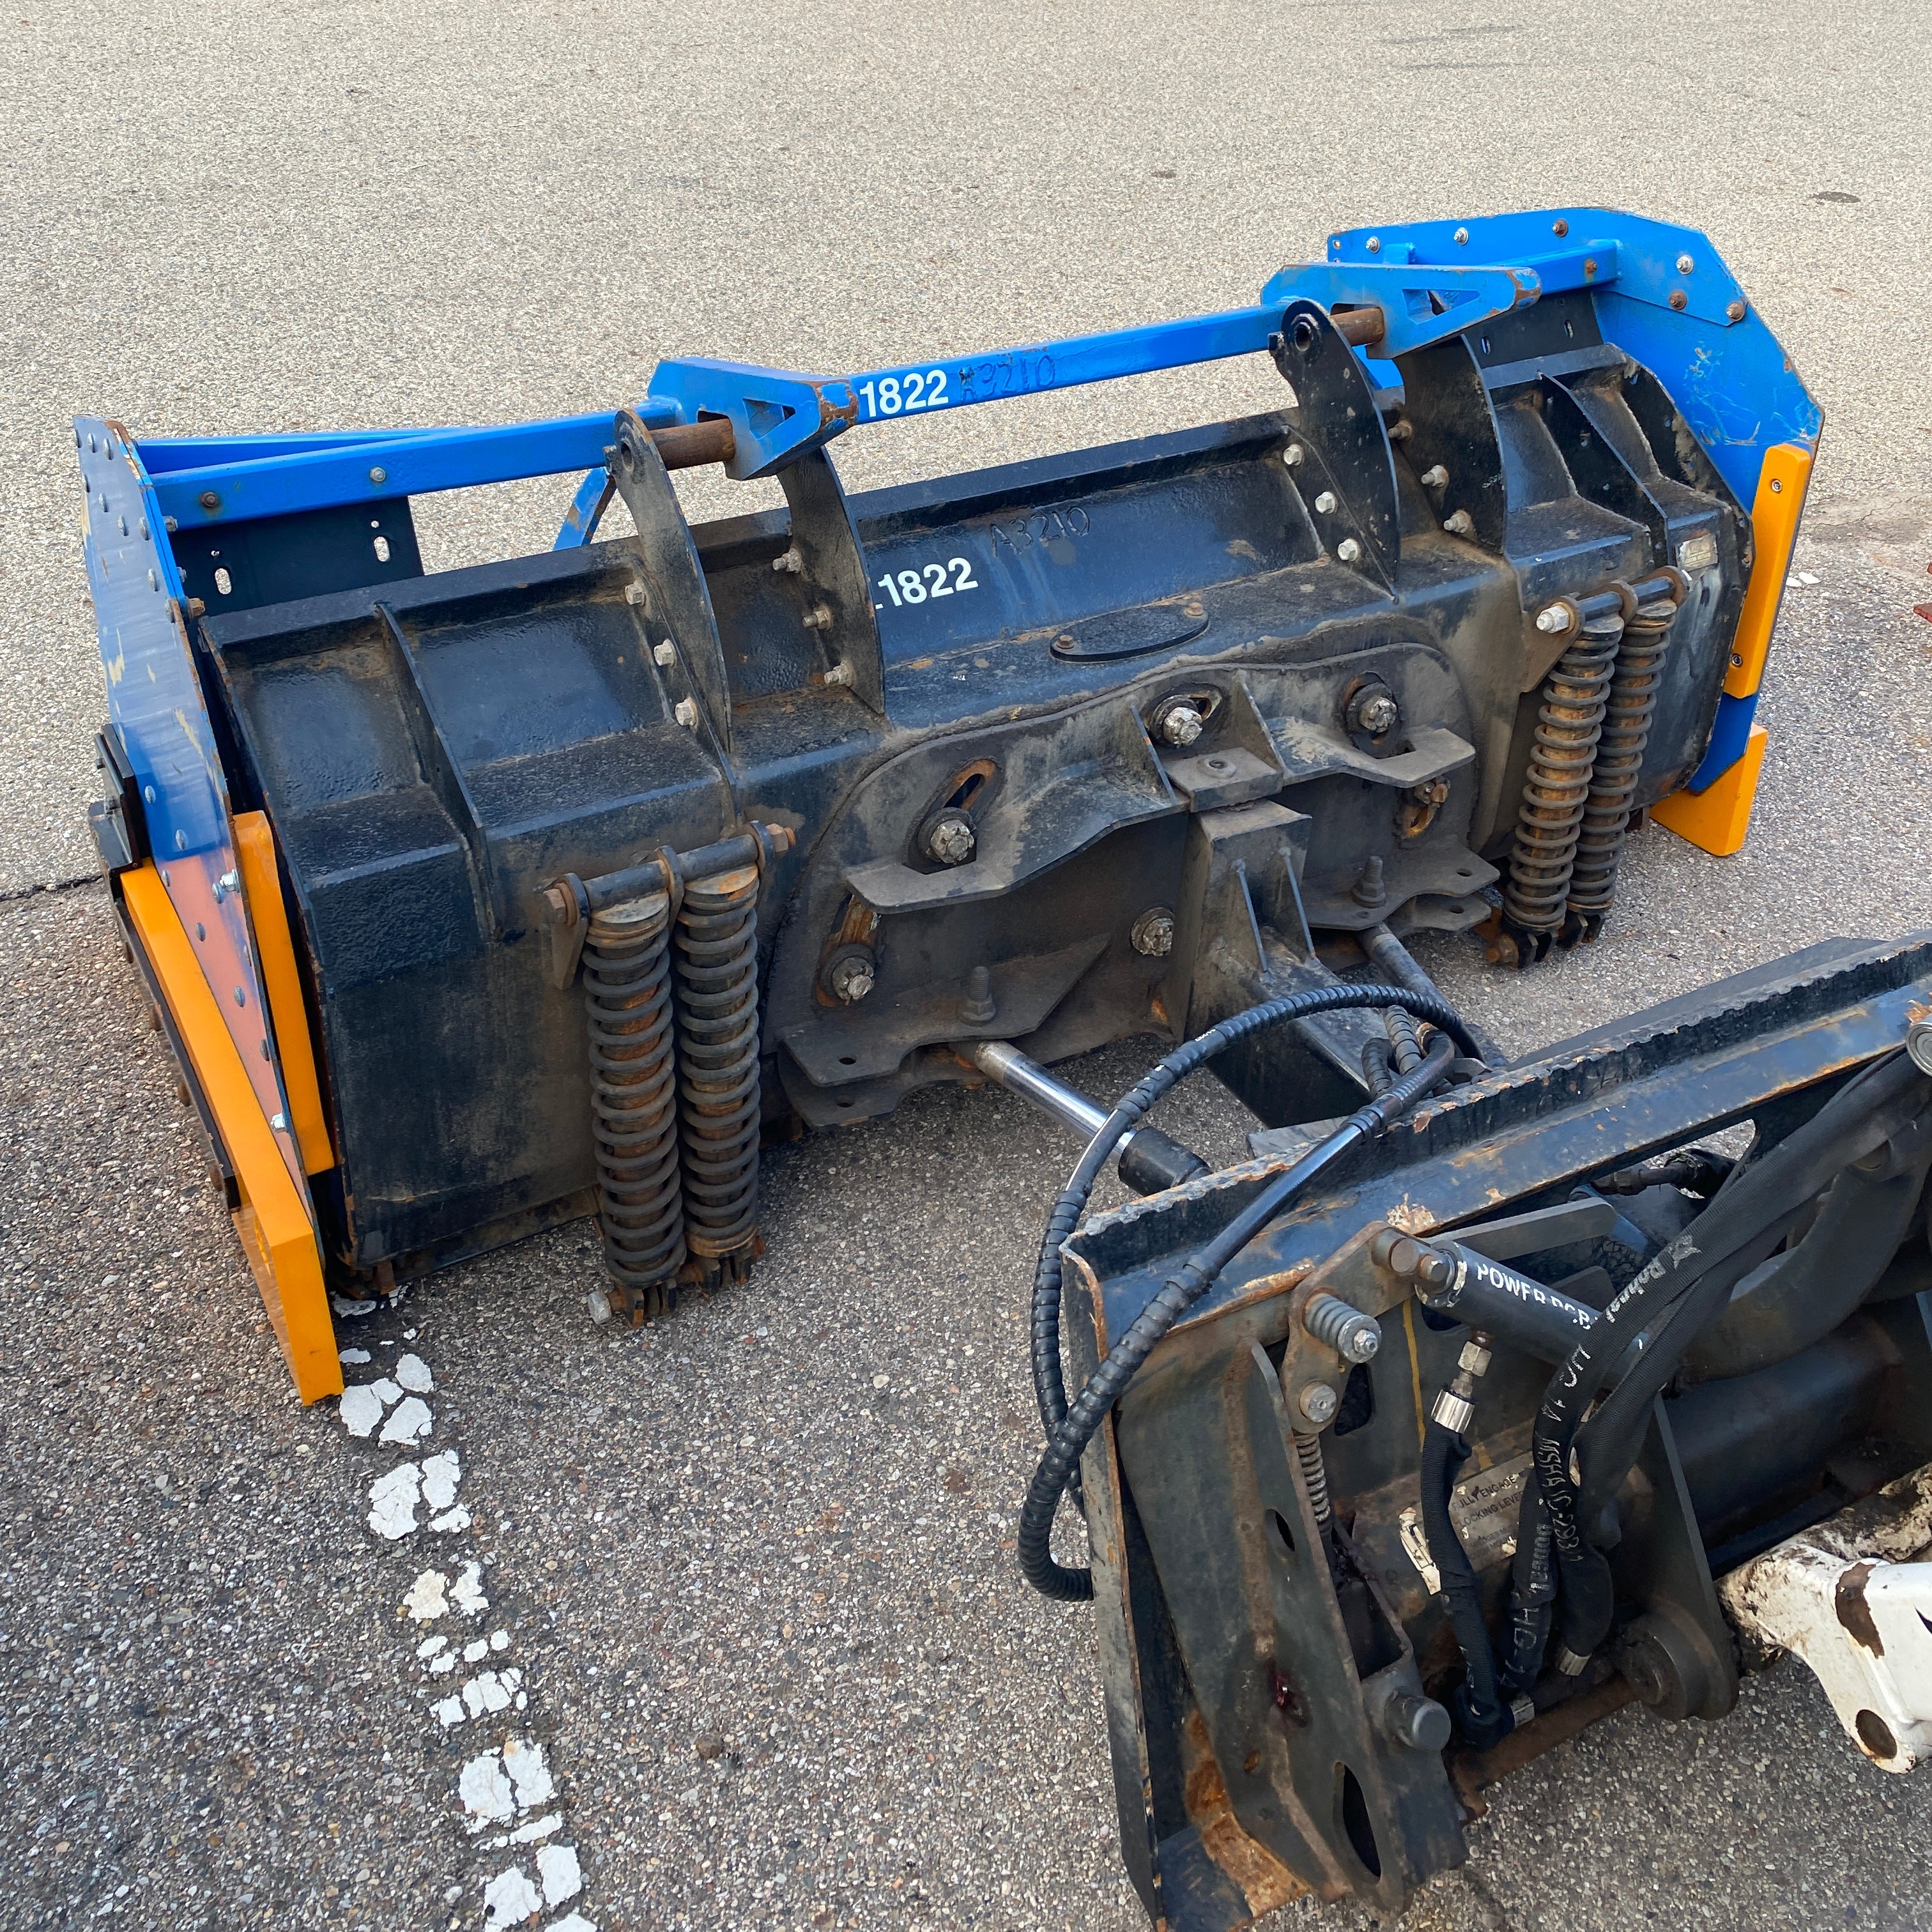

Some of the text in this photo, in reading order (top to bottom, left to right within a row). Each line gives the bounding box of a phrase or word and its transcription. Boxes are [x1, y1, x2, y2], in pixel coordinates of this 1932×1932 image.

[860, 369, 949, 417] 1822
[991, 507, 1090, 557] A3210
[875, 557, 978, 610] 1822
[1452, 1475, 1517, 1511] FULLY ENGAGE
